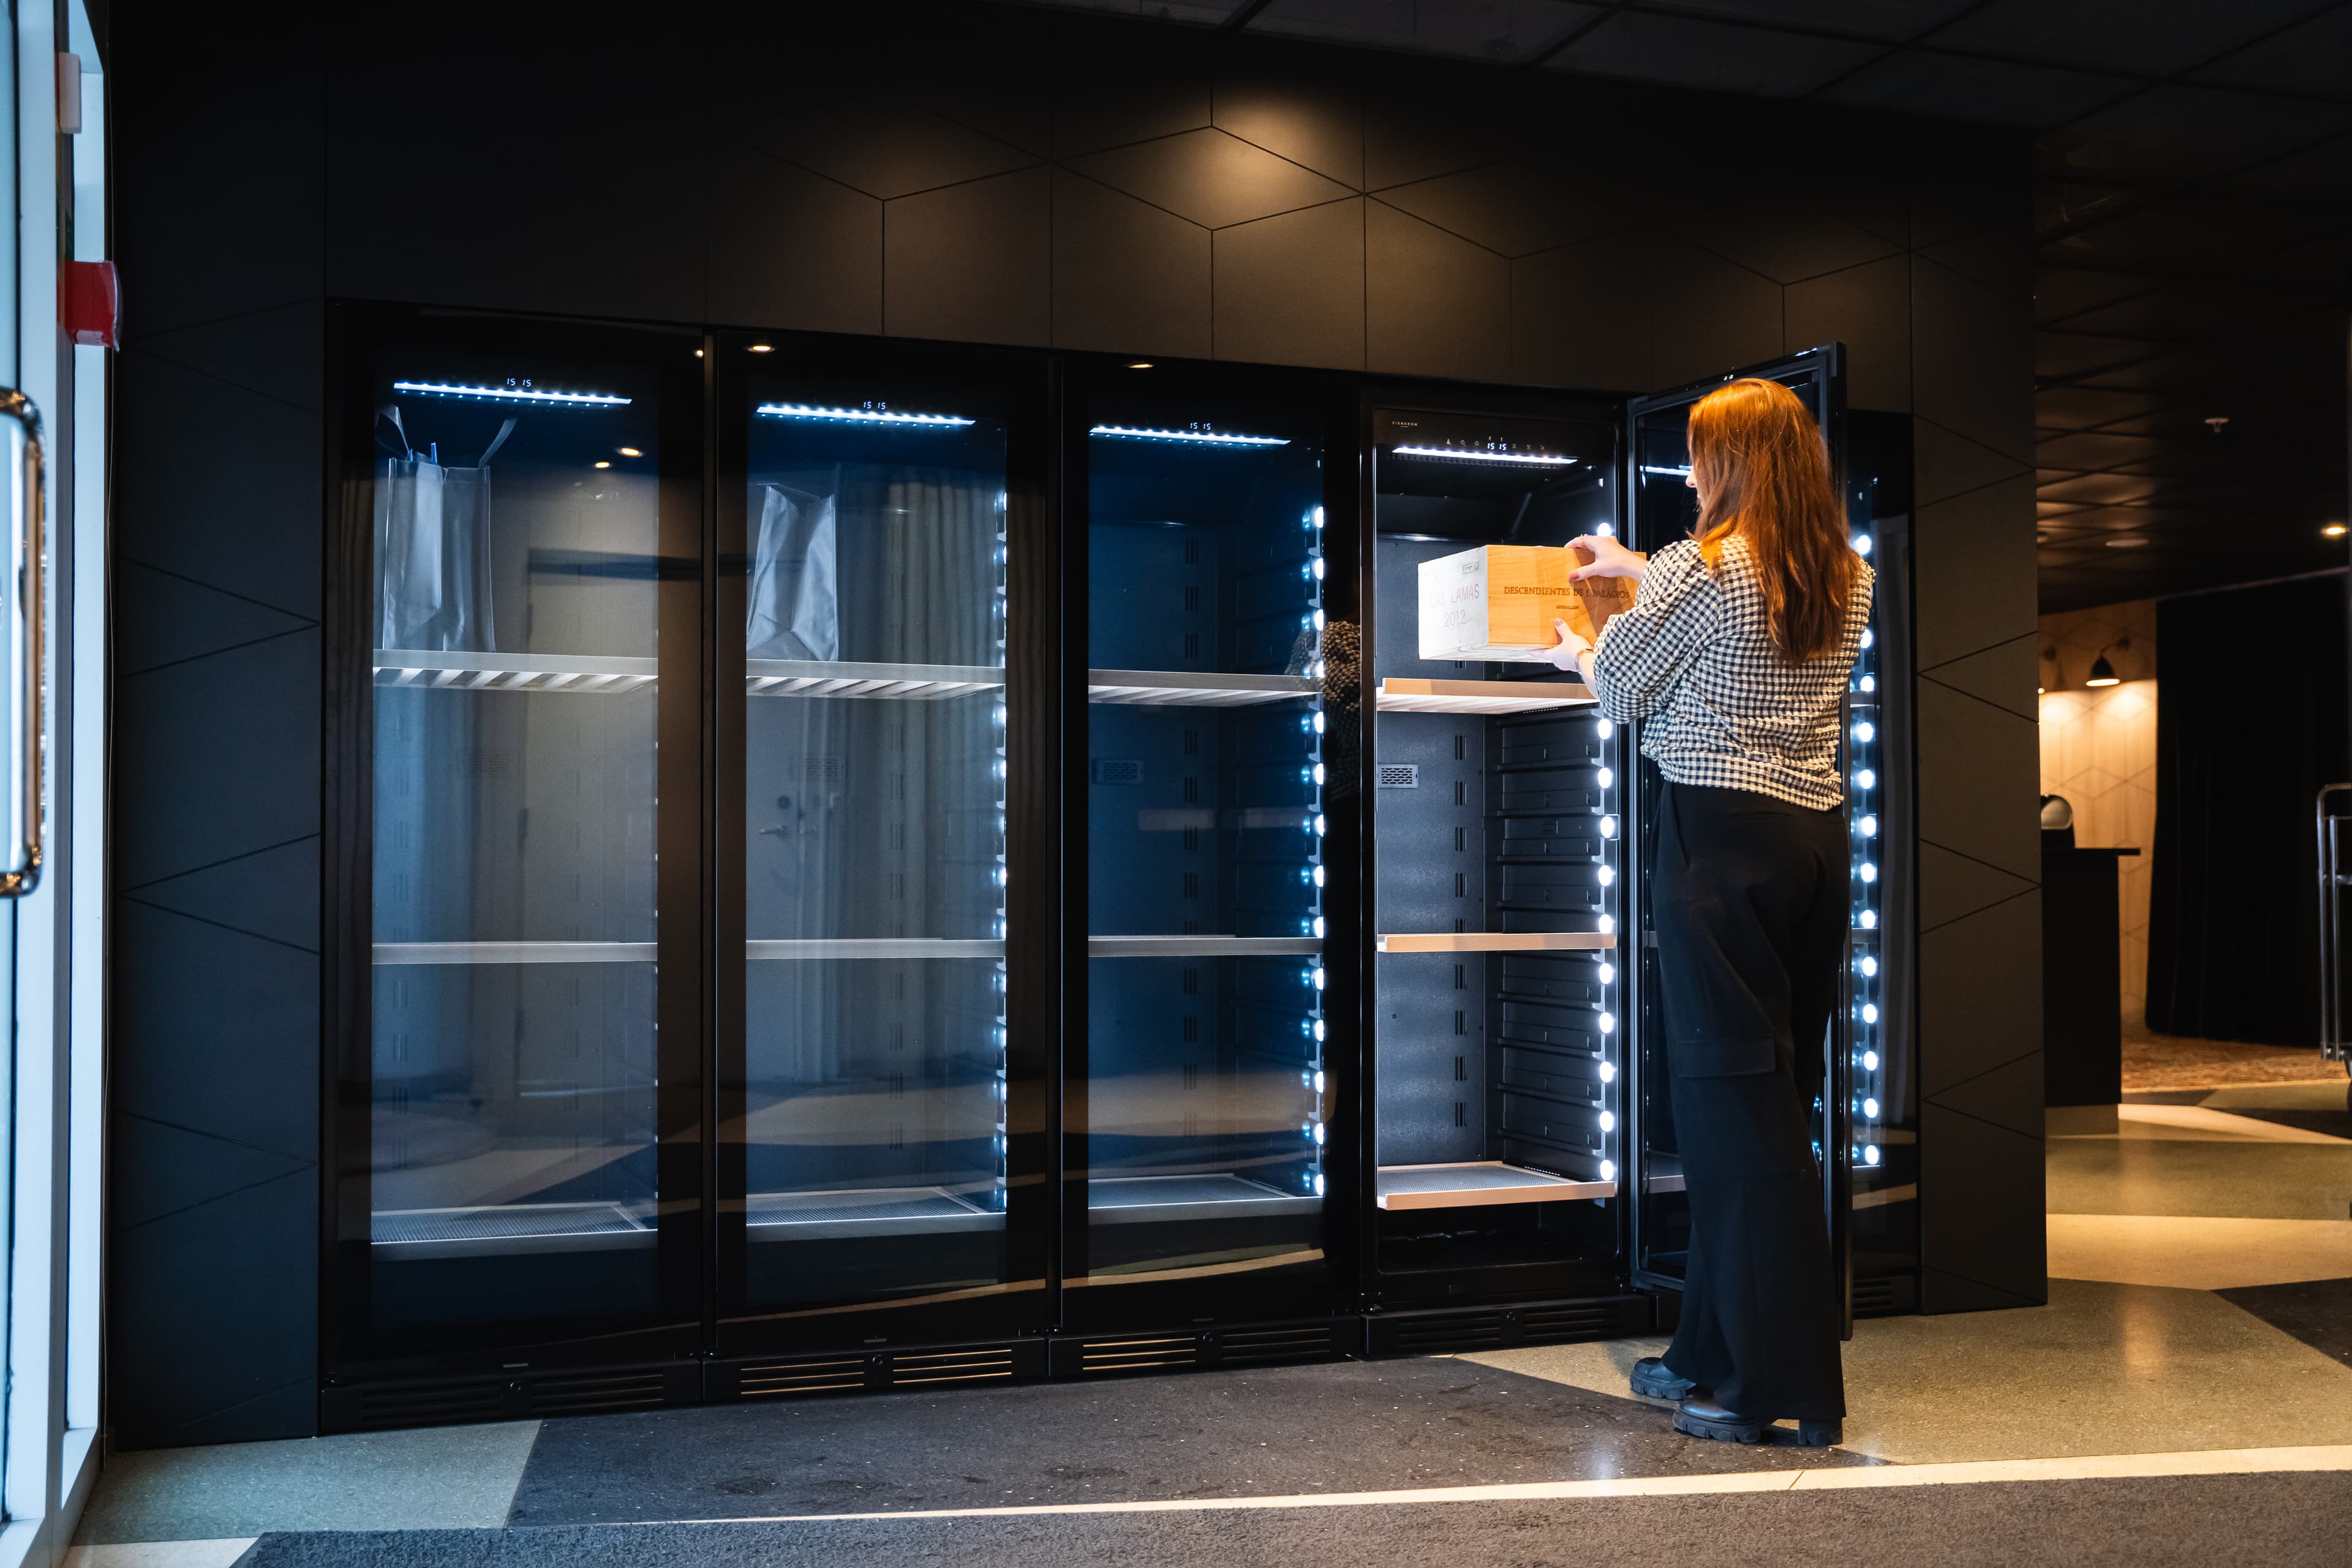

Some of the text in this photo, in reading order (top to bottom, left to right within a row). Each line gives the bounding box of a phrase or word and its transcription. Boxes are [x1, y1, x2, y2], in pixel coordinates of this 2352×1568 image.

[1450, 583, 1480, 603] LAMAS
[1504, 586, 1570, 596] DESCENDIENTES
[1573, 588, 1583, 597] DE
[1593, 589, 1630, 598] PALACIOS
[1444, 609, 1466, 628] 2012
